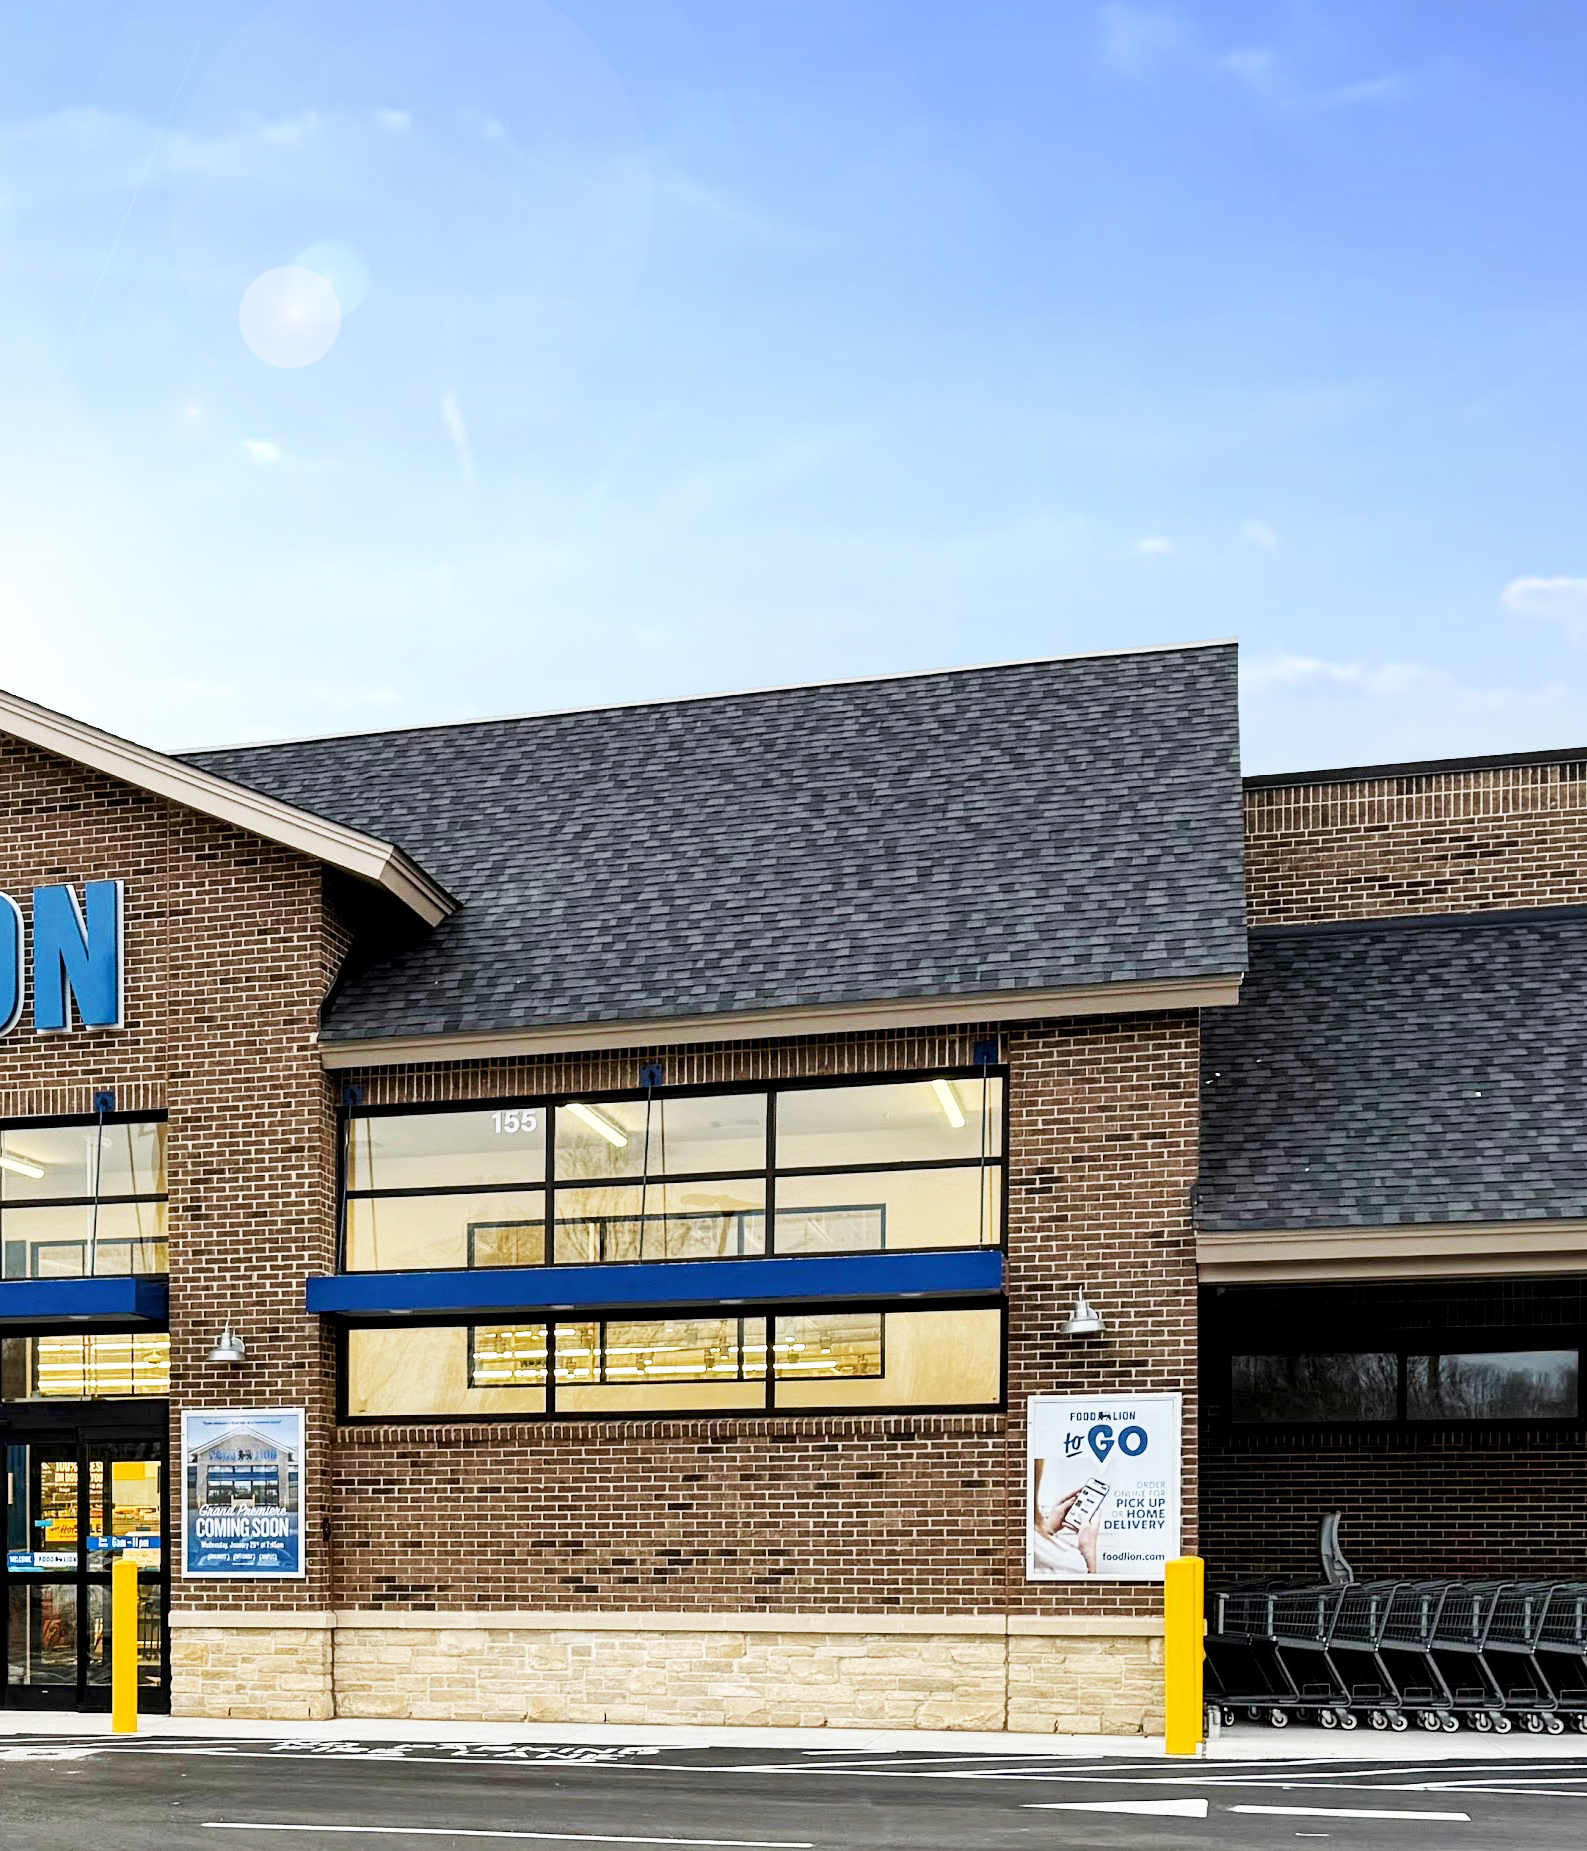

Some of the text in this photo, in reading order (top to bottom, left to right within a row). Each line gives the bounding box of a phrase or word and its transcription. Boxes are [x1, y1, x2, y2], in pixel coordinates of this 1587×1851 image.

[492, 1110, 537, 1134] 155
[1070, 1411, 1136, 1421] FOOD LION
[1063, 1424, 1148, 1463] to GO
[1136, 1481, 1165, 1489] ORDER
[1114, 1490, 1165, 1498] ONLINE FOR
[1116, 1498, 1165, 1508] PICK UP
[199, 1503, 287, 1517] Grand Premiere
[1127, 1509, 1165, 1518] HOME
[196, 1517, 289, 1538] COMING SOON
[1104, 1520, 1165, 1530] DELIVERY
[1102, 1551, 1165, 1561] foodlion.com
[451, 1750, 625, 1761] LANE
